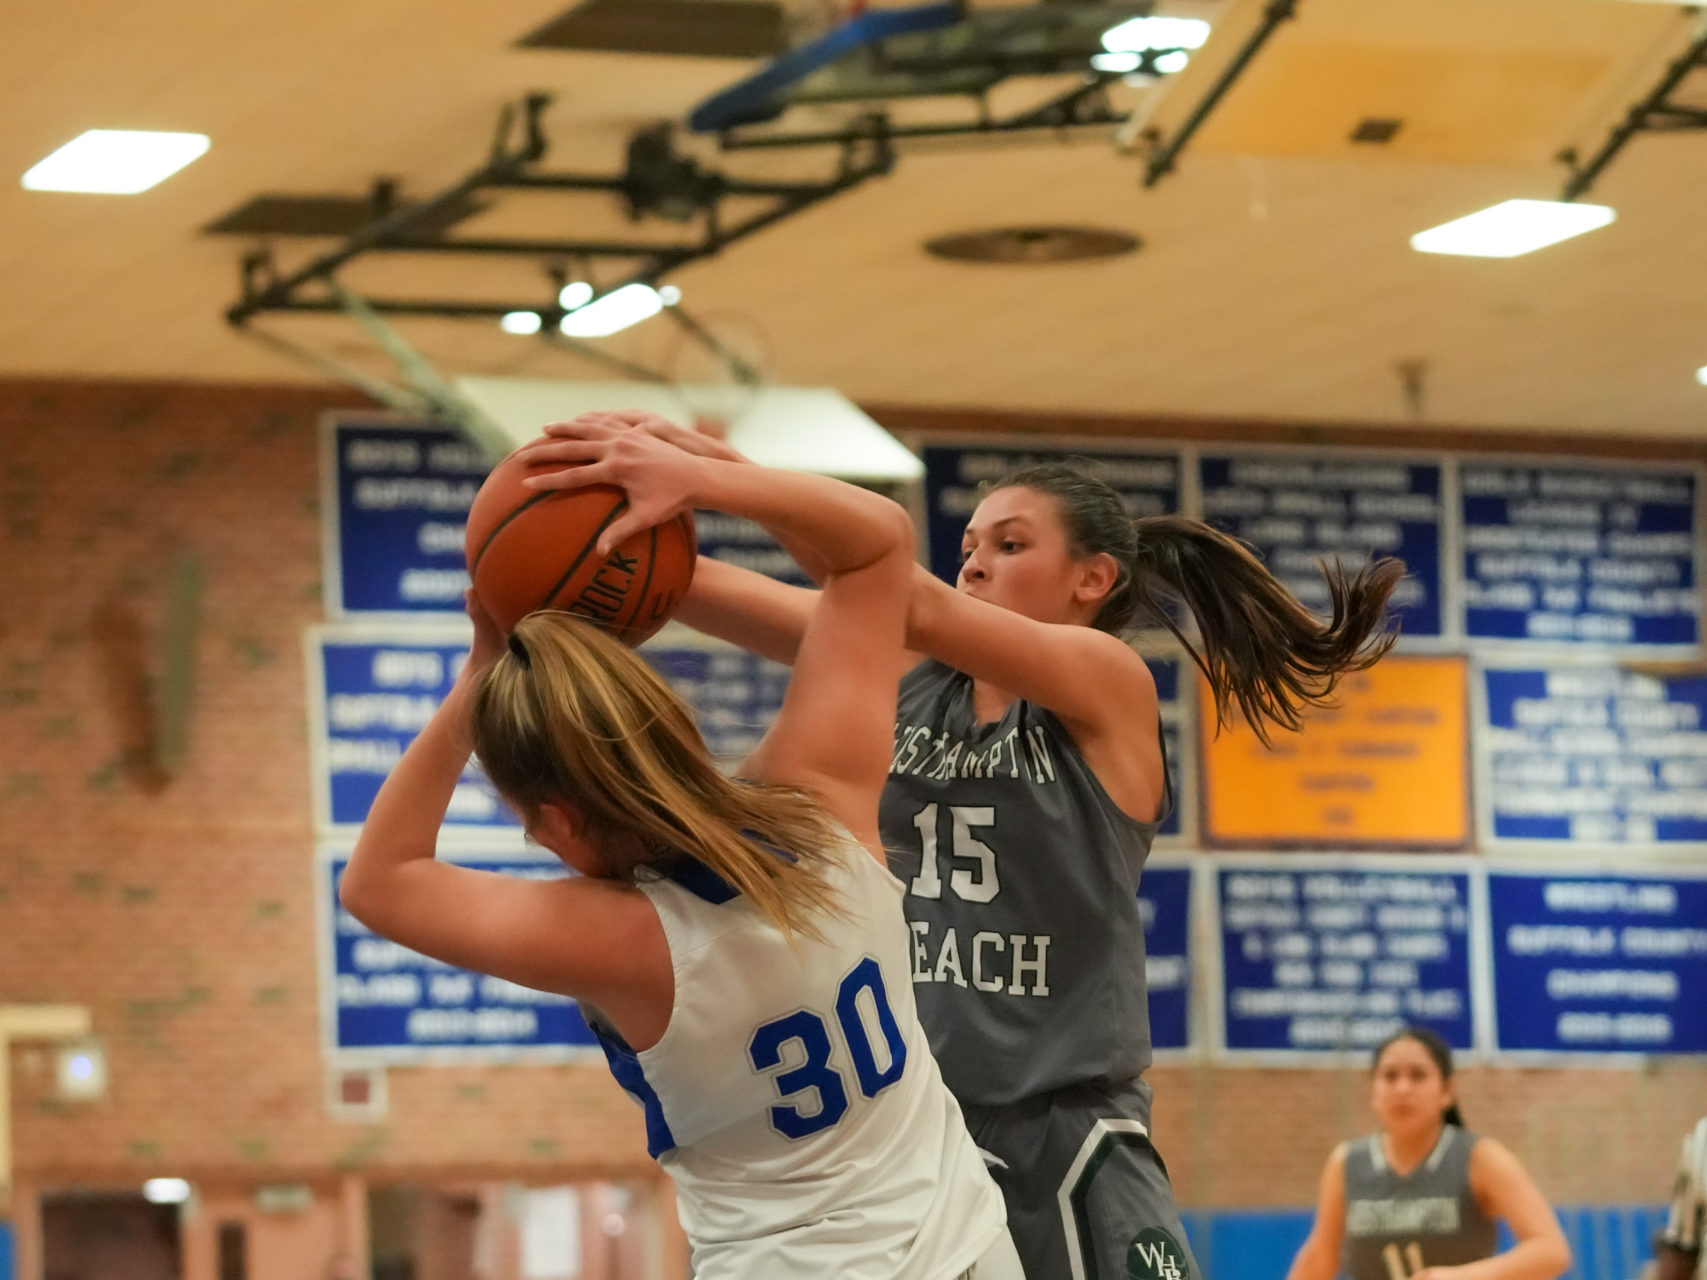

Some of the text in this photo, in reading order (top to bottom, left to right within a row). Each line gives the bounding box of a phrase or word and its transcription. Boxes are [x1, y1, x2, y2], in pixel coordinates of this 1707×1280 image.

[911, 803, 1000, 903] 15
[909, 921, 1051, 997] EACH
[748, 956, 908, 1140] 30
